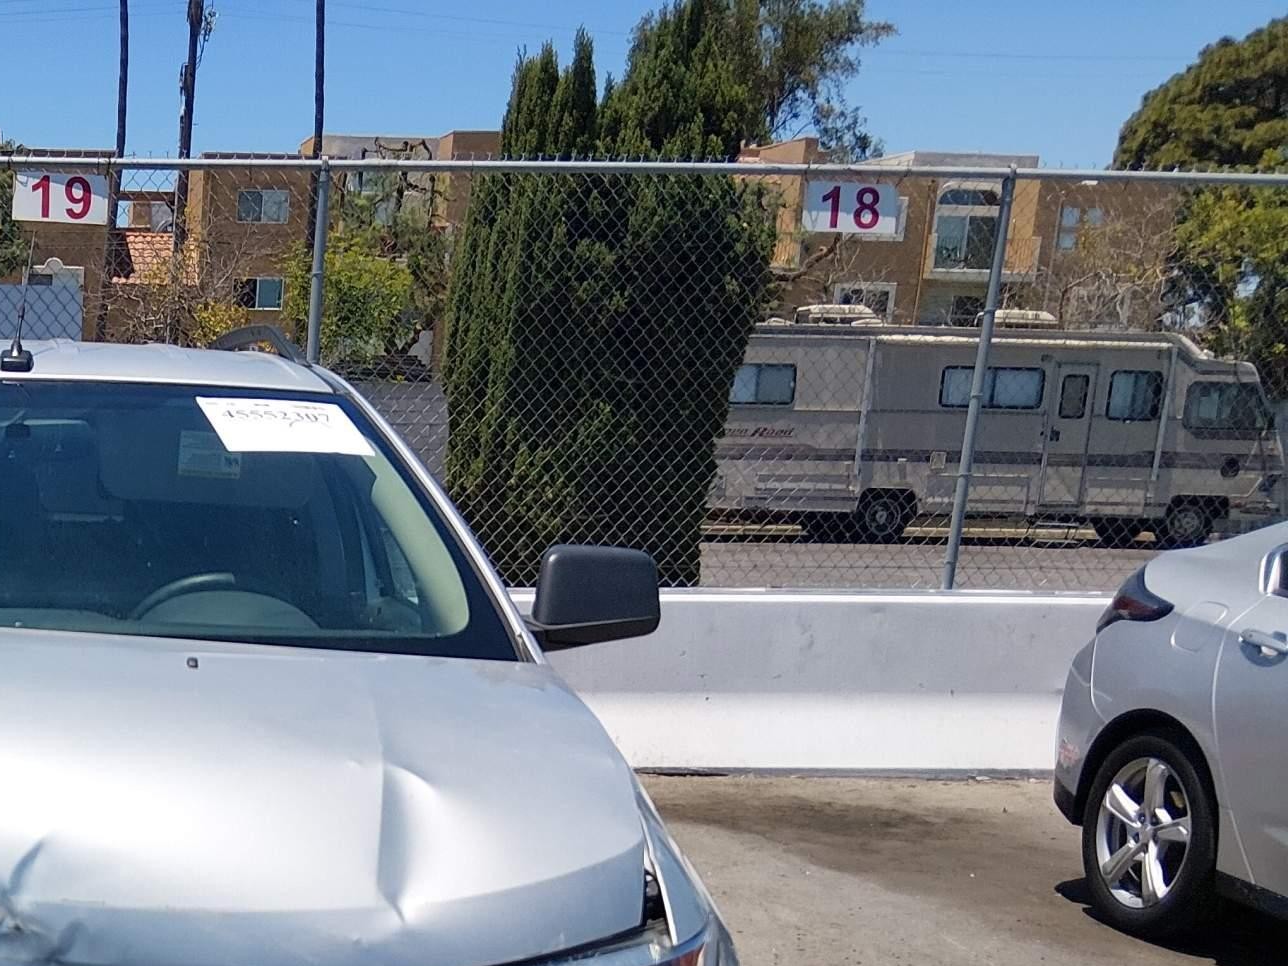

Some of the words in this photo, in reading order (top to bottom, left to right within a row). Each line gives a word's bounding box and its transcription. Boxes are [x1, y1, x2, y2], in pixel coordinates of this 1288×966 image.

[31, 174, 92, 220] 19
[821, 185, 880, 230] 18
[750, 426, 796, 438] Road
